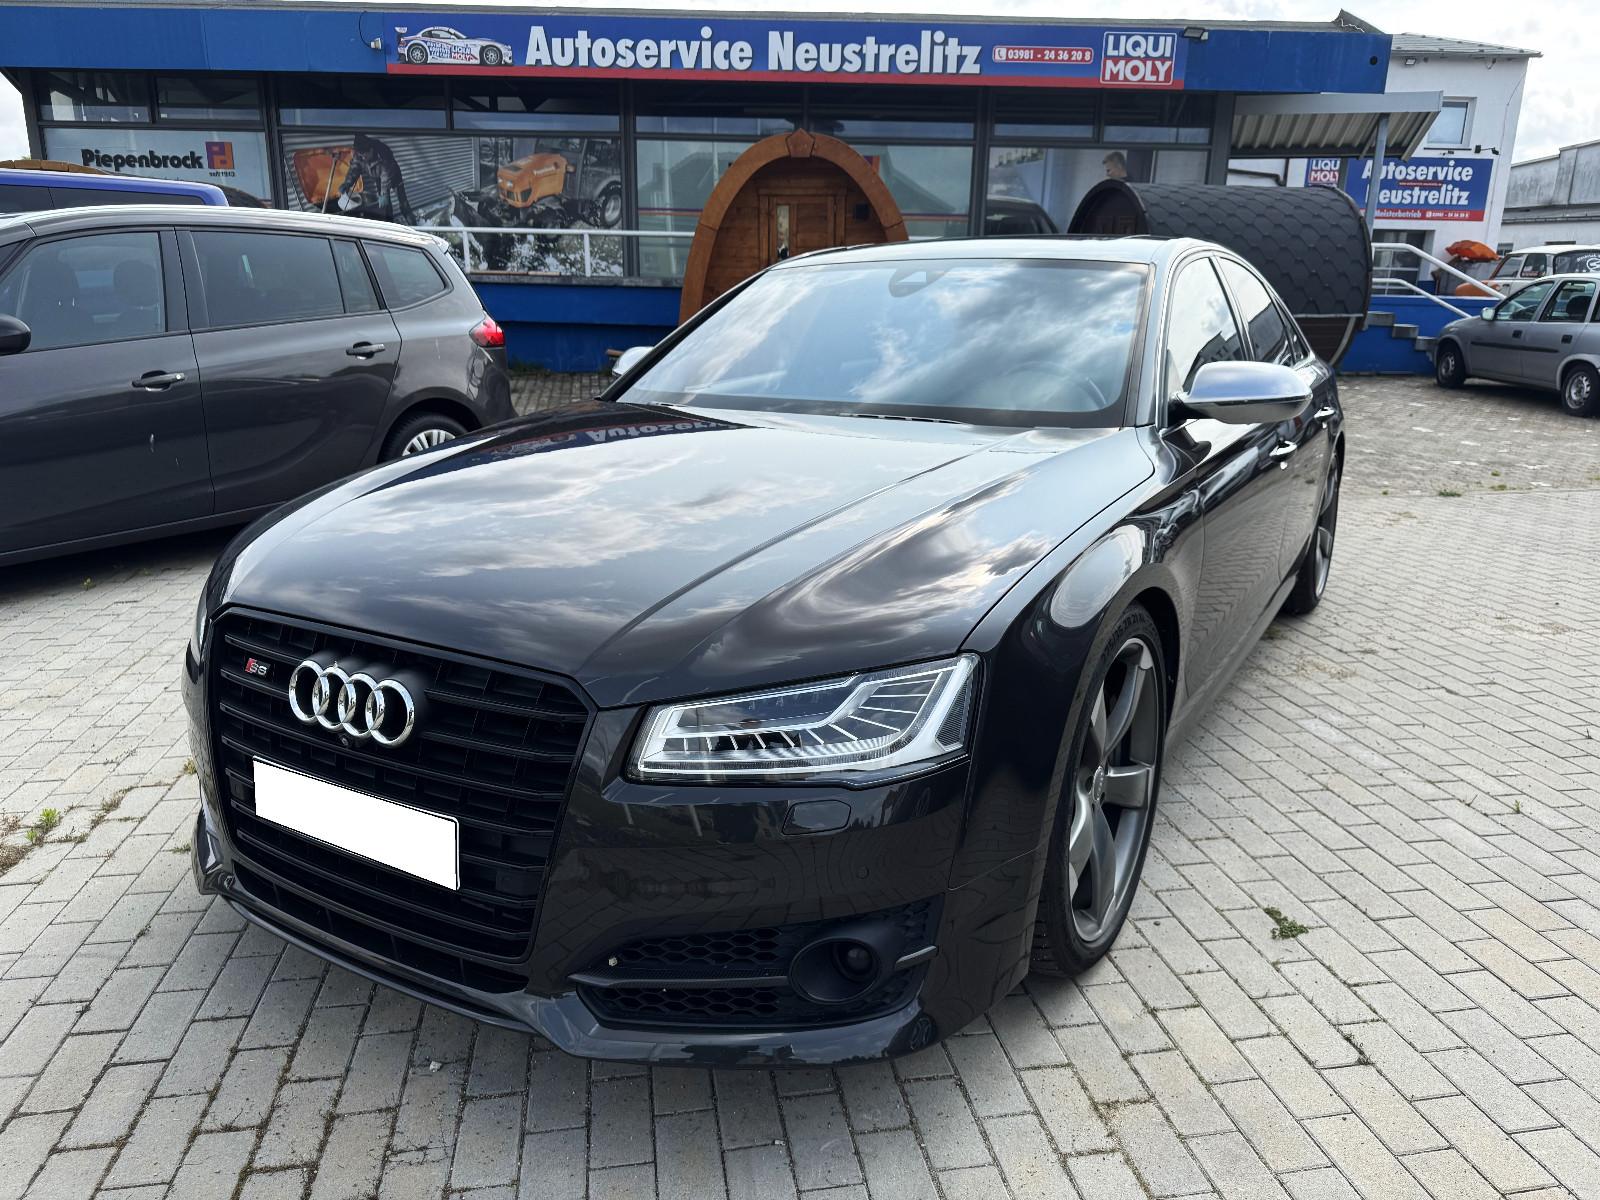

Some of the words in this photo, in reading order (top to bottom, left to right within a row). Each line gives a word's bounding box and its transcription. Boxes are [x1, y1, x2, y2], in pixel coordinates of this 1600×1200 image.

[525, 25, 753, 71] Autoservice
[767, 30, 981, 74] Neustrelitz
[1007, 49, 1034, 59] 03981
[1044, 50, 1055, 60] 24
[1057, 50, 1069, 60] 36
[1071, 51, 1083, 60] 20
[1084, 51, 1091, 61] 8
[1106, 34, 1172, 58] LIQUI
[1104, 59, 1172, 82] MOLY
[81, 149, 204, 172] Piepenbrock
[1312, 159, 1341, 171] LIQU
[1365, 183, 1470, 205] eustrelitz
